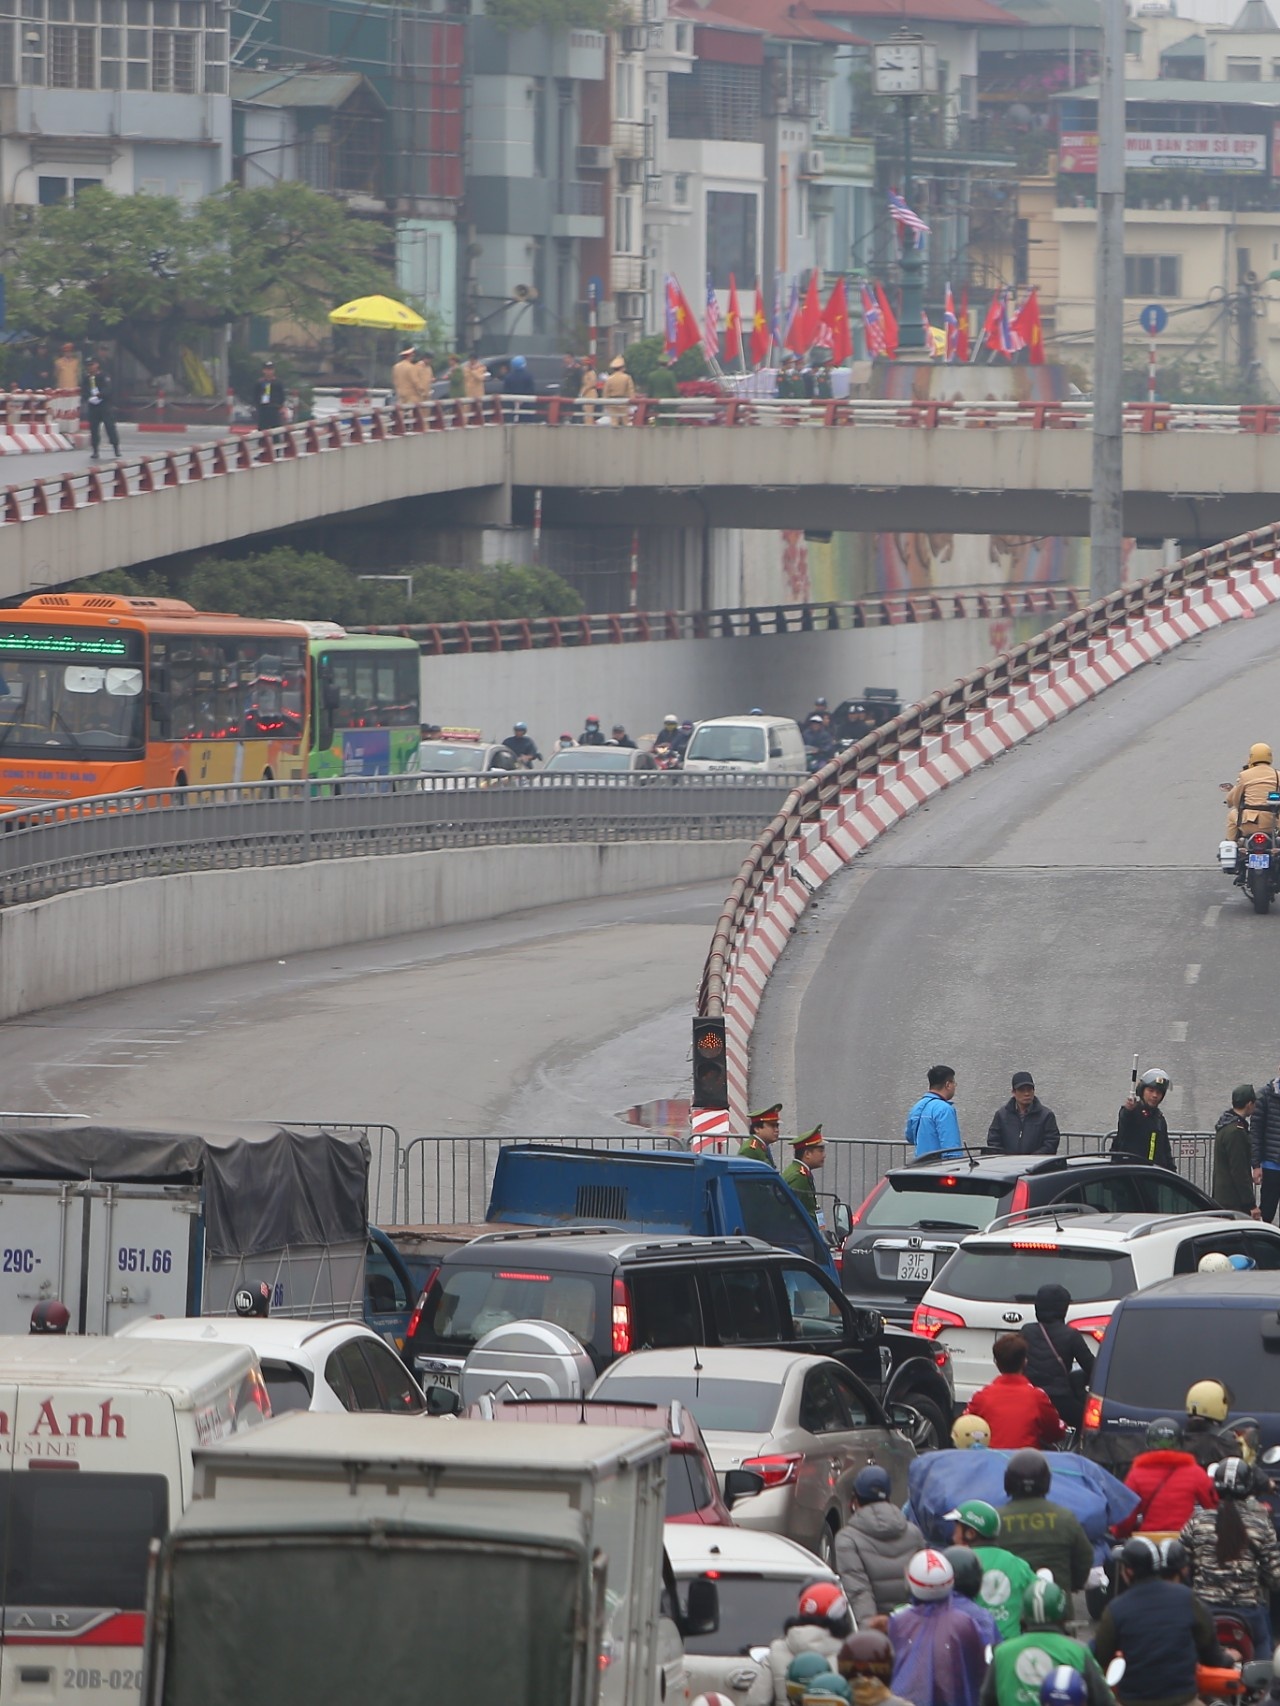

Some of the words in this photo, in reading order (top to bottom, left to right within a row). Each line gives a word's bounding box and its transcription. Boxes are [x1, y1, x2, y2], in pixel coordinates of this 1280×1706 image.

[1127, 139, 1152, 151] MUA
[1186, 139, 1208, 152] SIM
[3, 1248, 42, 1273] 29C-
[118, 1247, 172, 1274] 951.66
[907, 1254, 924, 1267] 31F
[901, 1266, 929, 1280] 3749
[1004, 1312, 1021, 1322] KIA
[1002, 1512, 1058, 1533] TTGT
